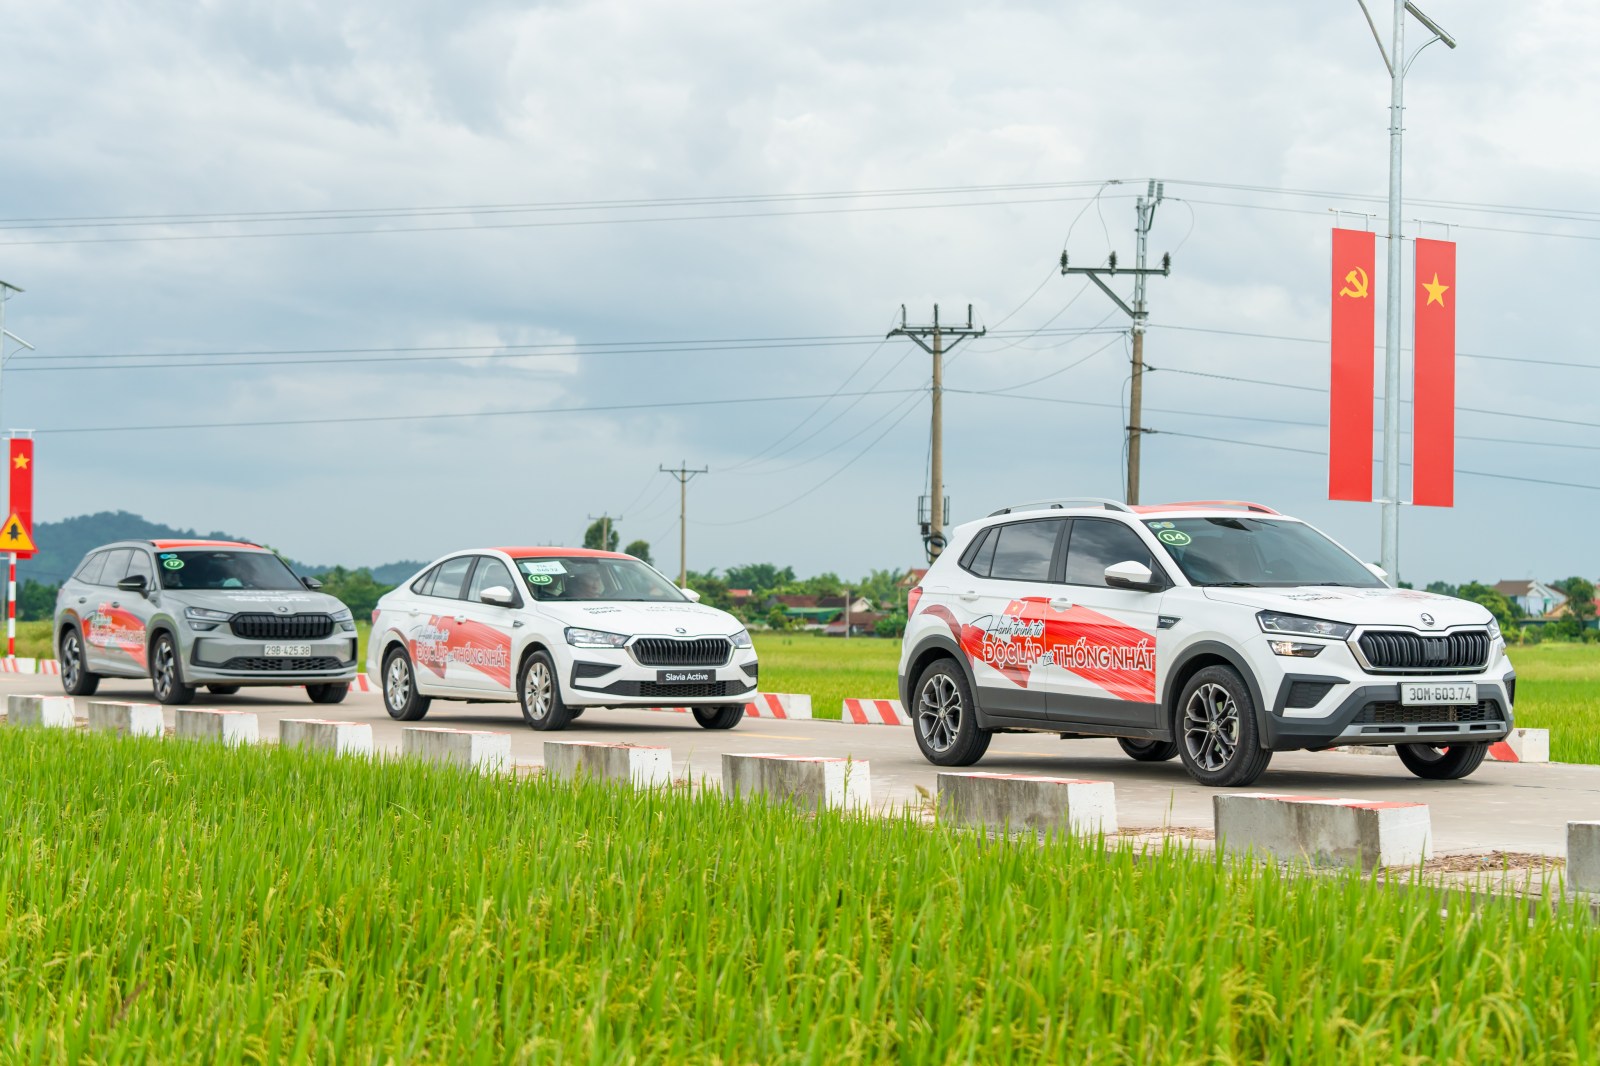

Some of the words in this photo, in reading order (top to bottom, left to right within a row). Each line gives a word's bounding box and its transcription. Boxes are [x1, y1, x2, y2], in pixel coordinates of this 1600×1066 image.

[1162, 533, 1186, 542] 04
[970, 614, 1013, 641] Hành
[1013, 620, 1034, 637] trình
[1034, 620, 1045, 637] từ
[453, 642, 484, 665] THỐNG
[484, 644, 507, 667] NHẤT
[983, 638, 1016, 669] ĐỘC
[1016, 637, 1043, 670] LẬP
[1054, 637, 1111, 669] THỐNG
[1111, 638, 1156, 671] NHẤT
[665, 672, 686, 681] Slavia
[687, 672, 709, 681] Active
[1409, 687, 1471, 701] 30M-603.74
